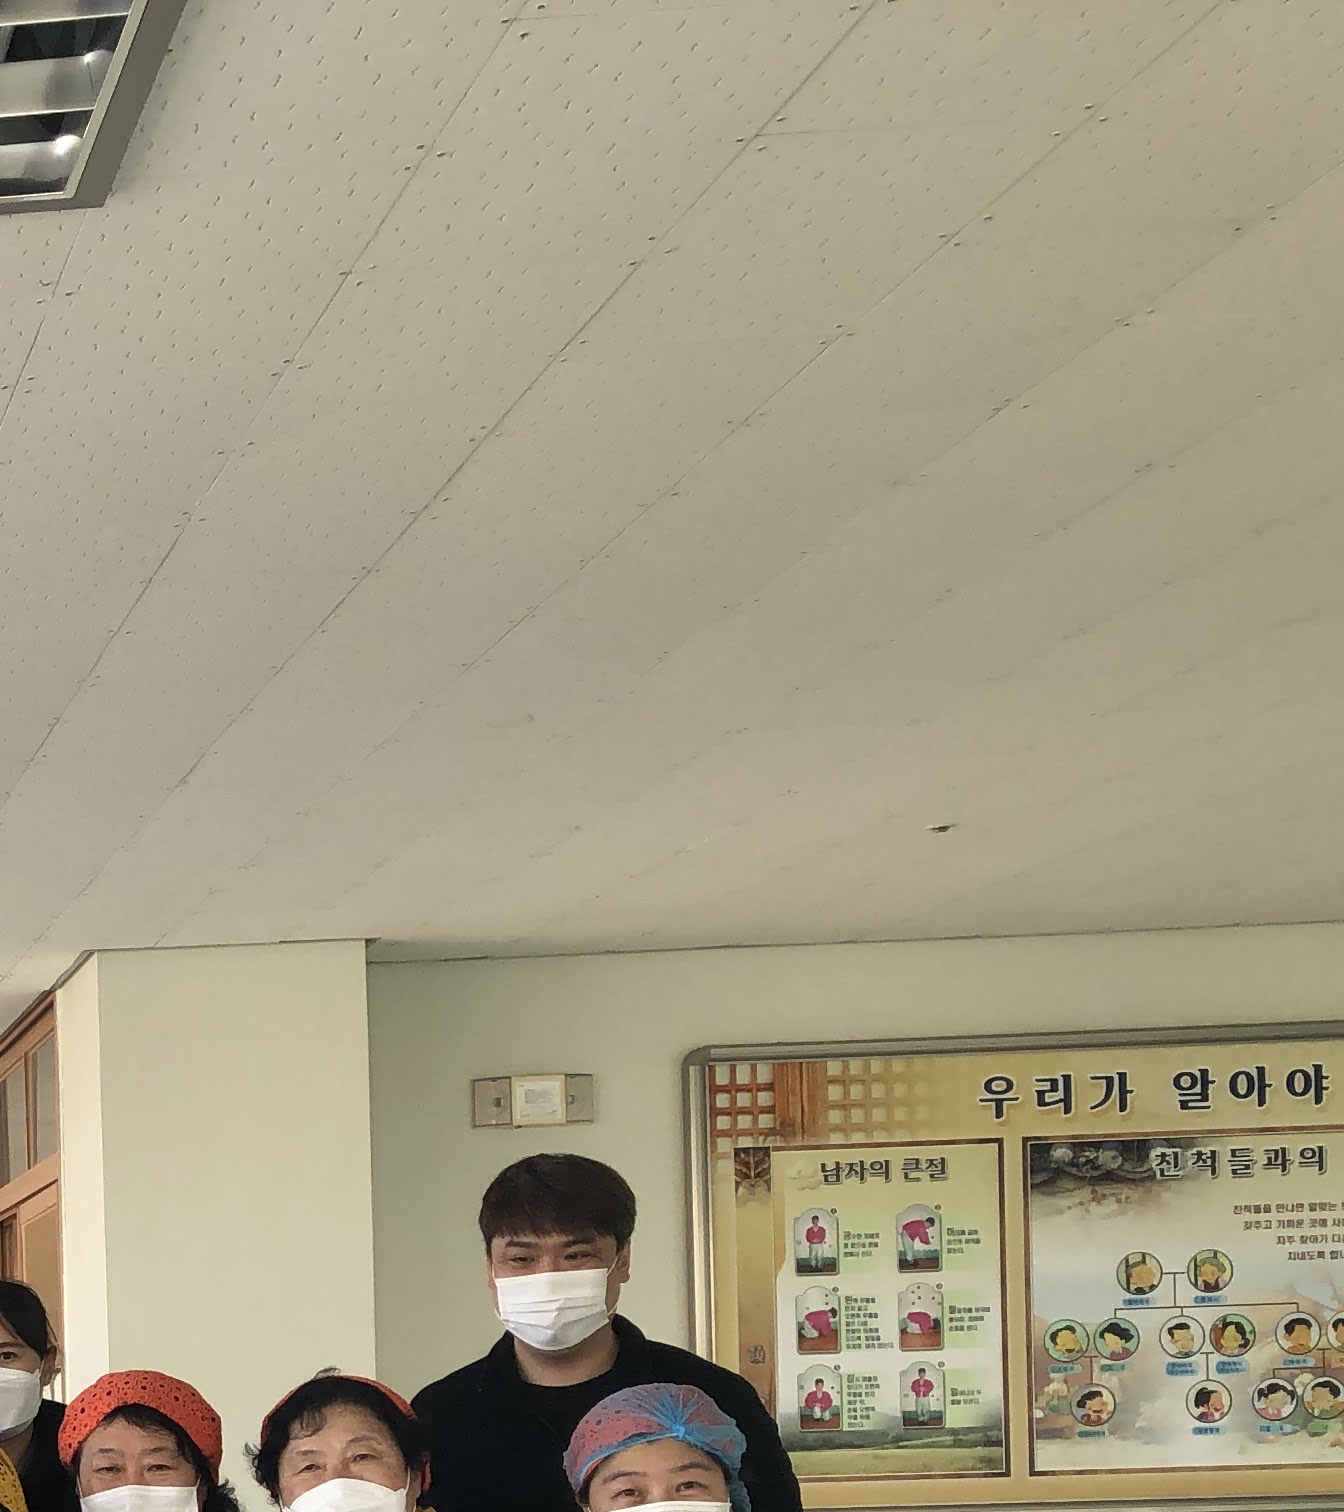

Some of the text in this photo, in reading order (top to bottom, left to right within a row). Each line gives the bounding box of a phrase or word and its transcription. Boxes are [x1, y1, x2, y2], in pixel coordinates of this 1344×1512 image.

[979, 1064, 1330, 1120] 우리가 알아야
[820, 1156, 947, 1184] 남자의 큰절
[1154, 1145, 1325, 1178] 친척들과의
